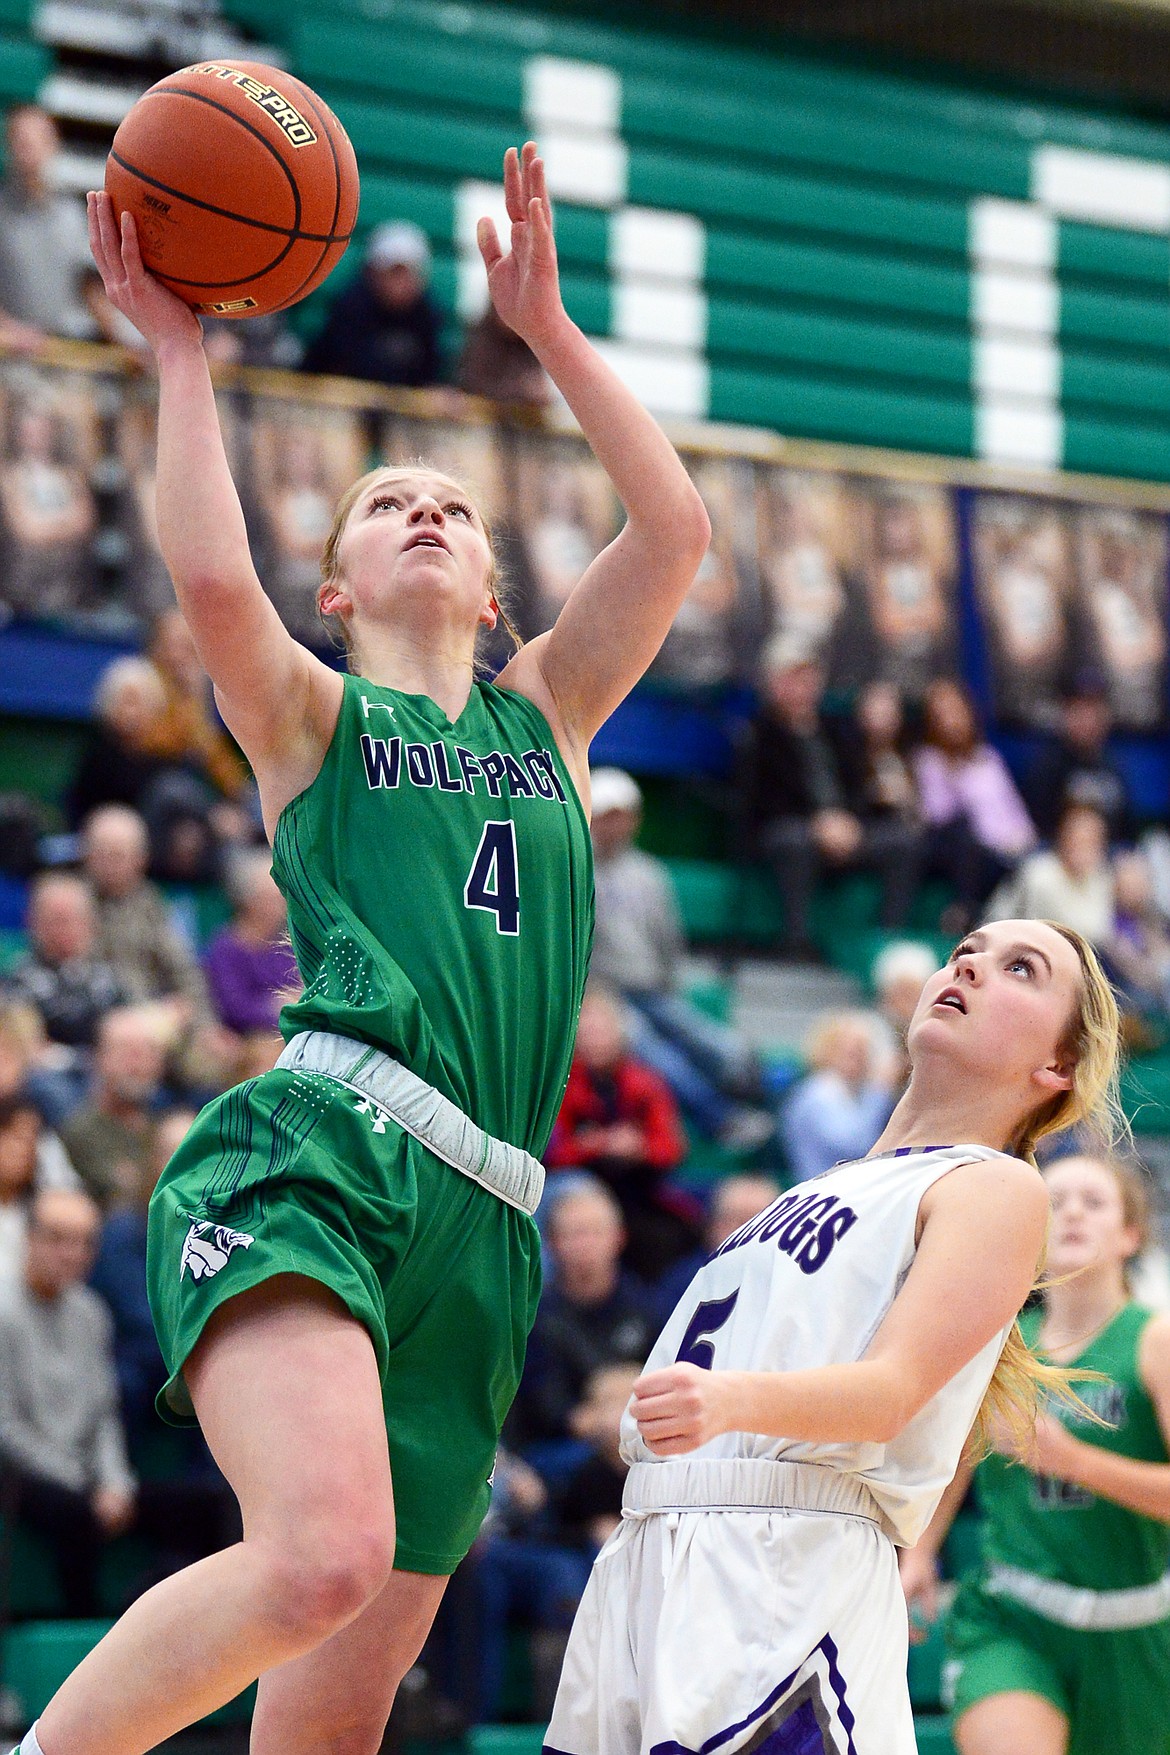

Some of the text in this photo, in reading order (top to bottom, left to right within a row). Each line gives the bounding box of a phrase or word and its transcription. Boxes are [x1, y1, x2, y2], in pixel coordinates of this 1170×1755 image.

[257, 86, 318, 148] PRO
[463, 818, 520, 937] 4
[674, 1286, 741, 1372] 5
